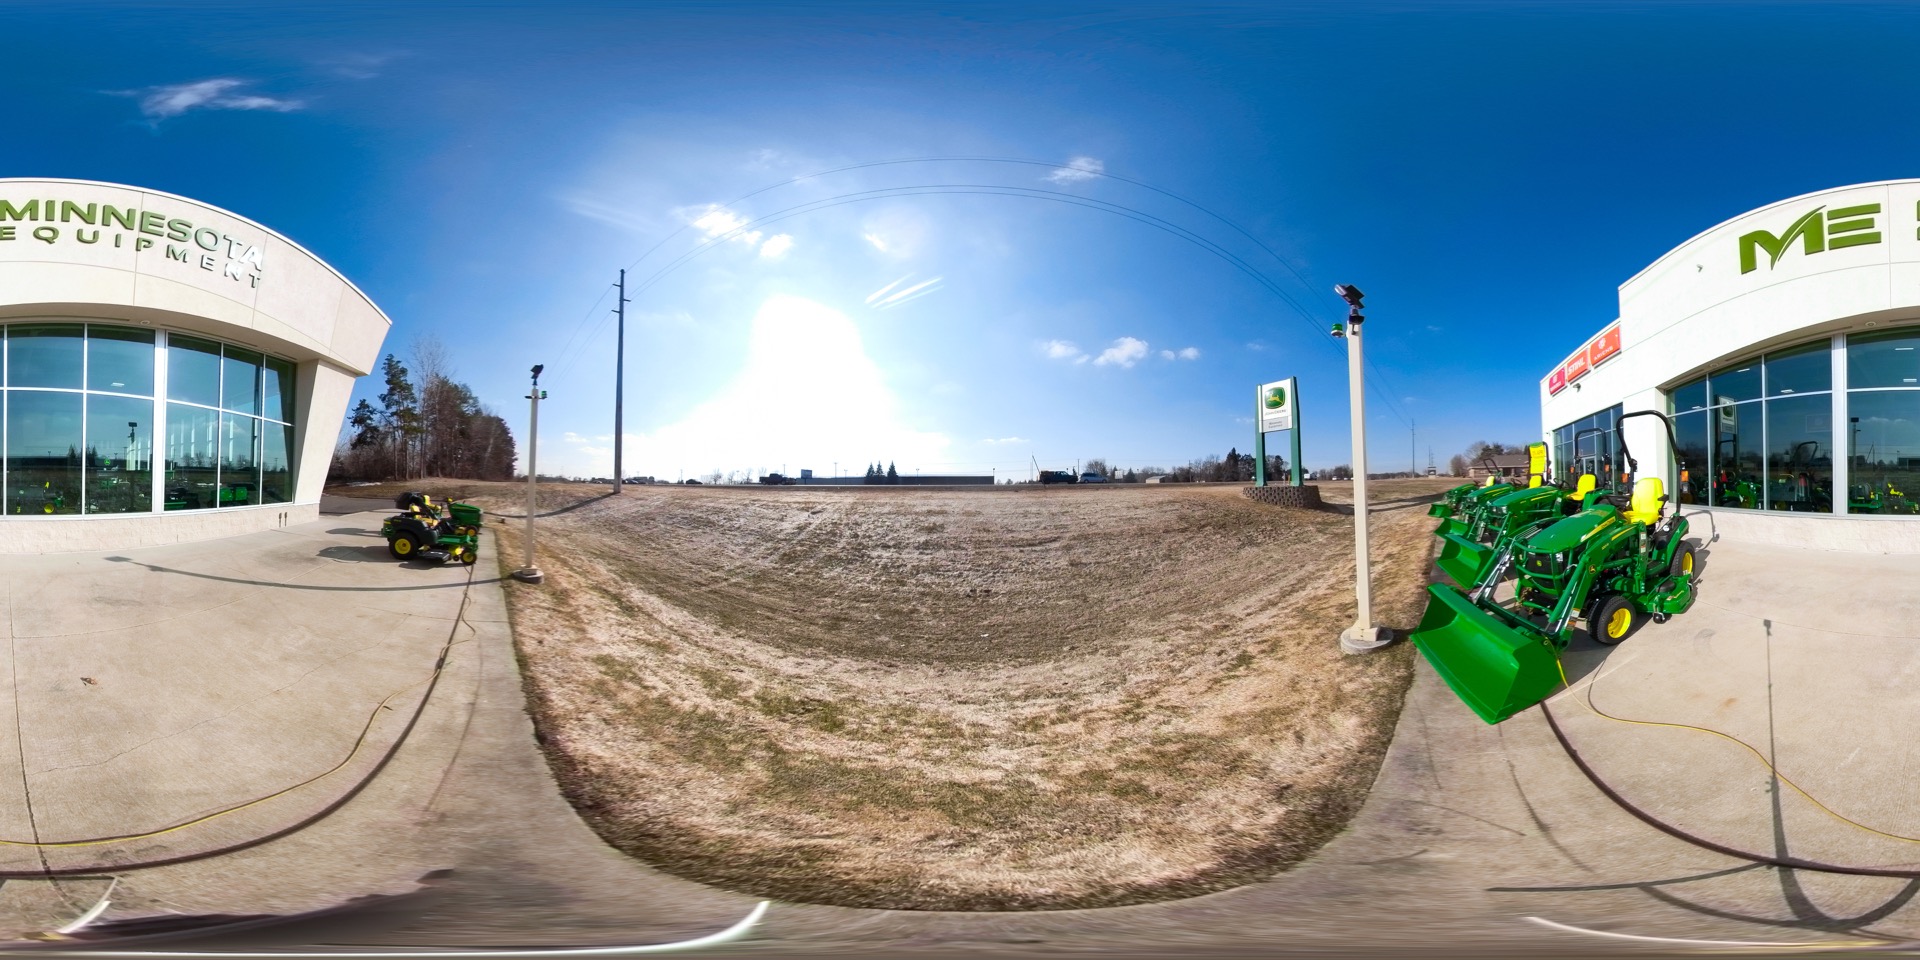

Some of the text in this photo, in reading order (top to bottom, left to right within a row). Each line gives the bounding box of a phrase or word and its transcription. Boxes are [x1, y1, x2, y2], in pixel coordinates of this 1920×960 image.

[0, 199, 263, 271] MINNESOTA
[0, 226, 261, 288] EQUIPMENT
[1739, 203, 1882, 275] ME
